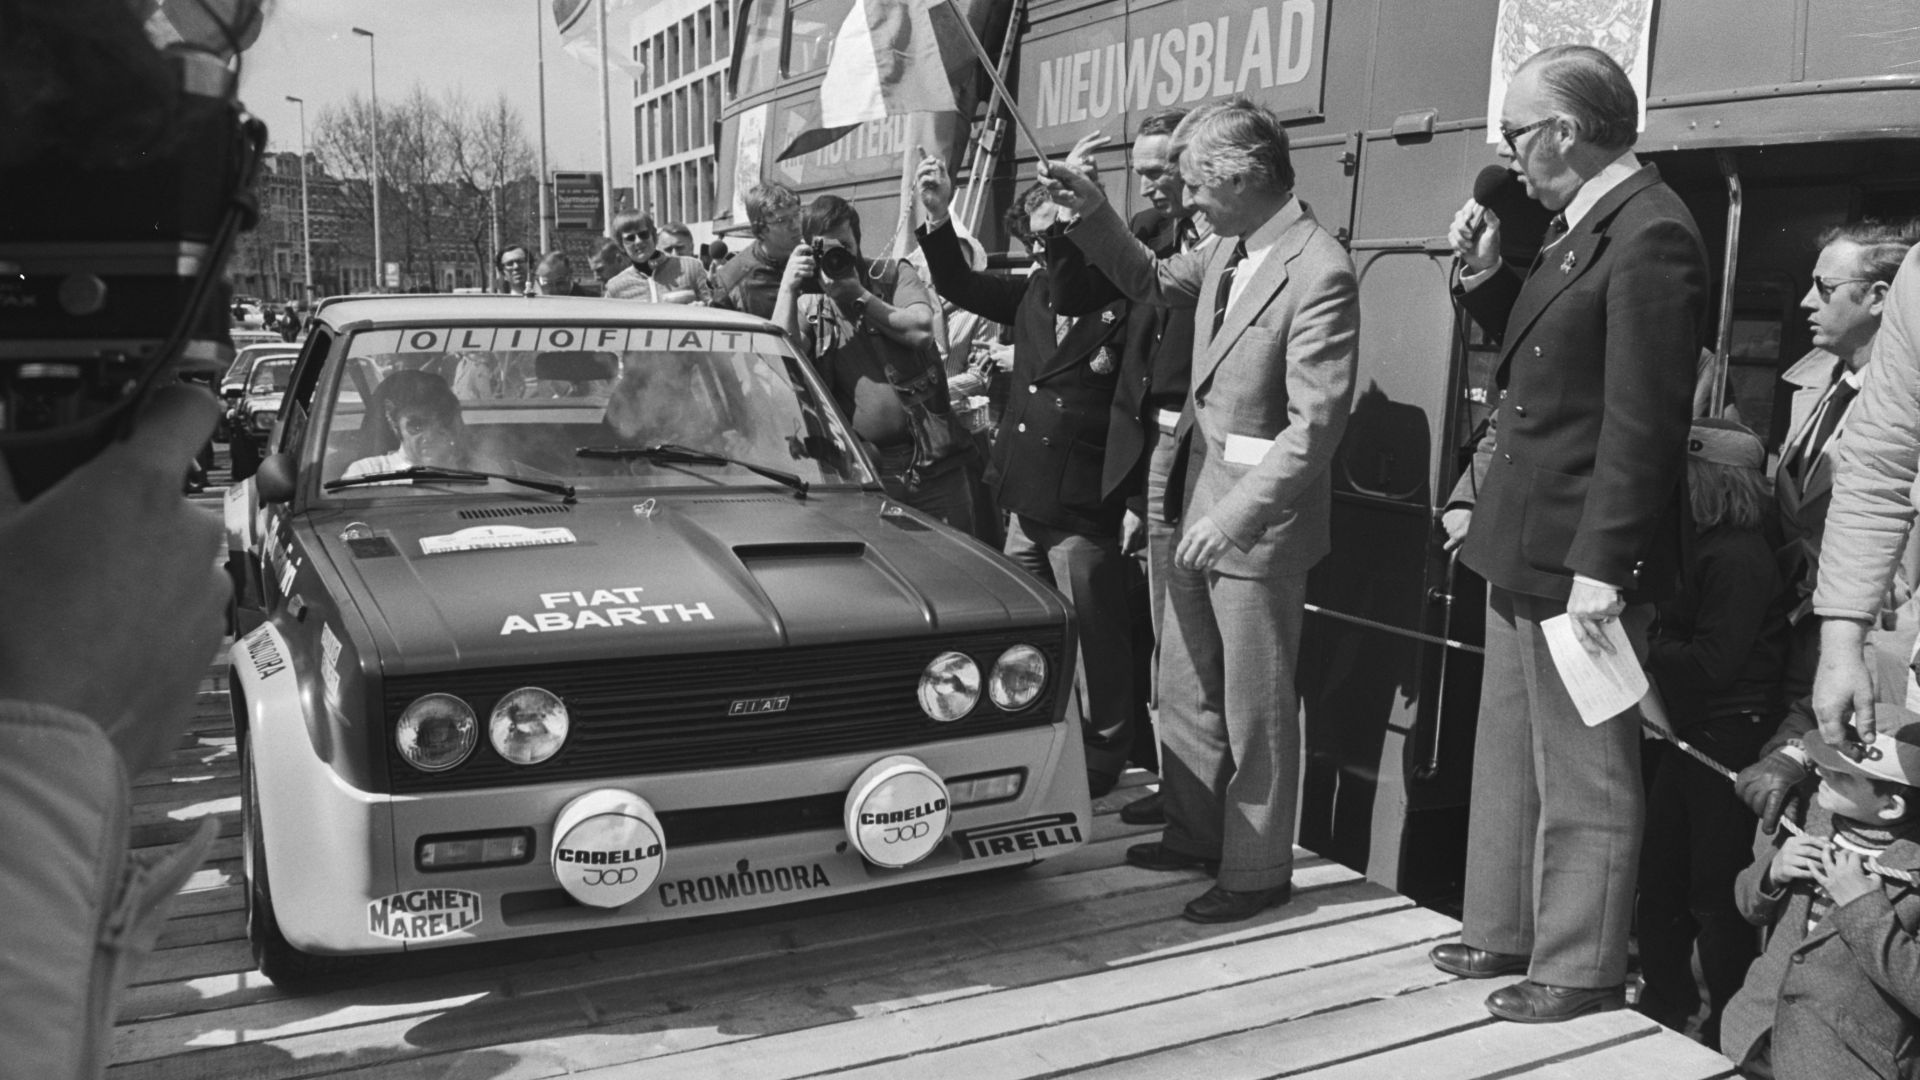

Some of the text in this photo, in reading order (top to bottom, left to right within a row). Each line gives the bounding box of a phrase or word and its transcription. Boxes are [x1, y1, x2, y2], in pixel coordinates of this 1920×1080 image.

[1036, 0, 1315, 129] NIEUWSBLAD
[540, 587, 644, 609] FIAT
[500, 602, 715, 635] ABARTH
[734, 698, 786, 713] FIAT
[860, 798, 946, 826] CARELLO
[883, 821, 930, 844] JOD
[952, 812, 1082, 860] PIRELLI
[558, 844, 661, 865] CARELLO
[582, 867, 638, 886] JOD
[657, 863, 830, 908] CROMODORA
[370, 889, 480, 926] MAGNETI
[370, 898, 480, 938] MARELLI
